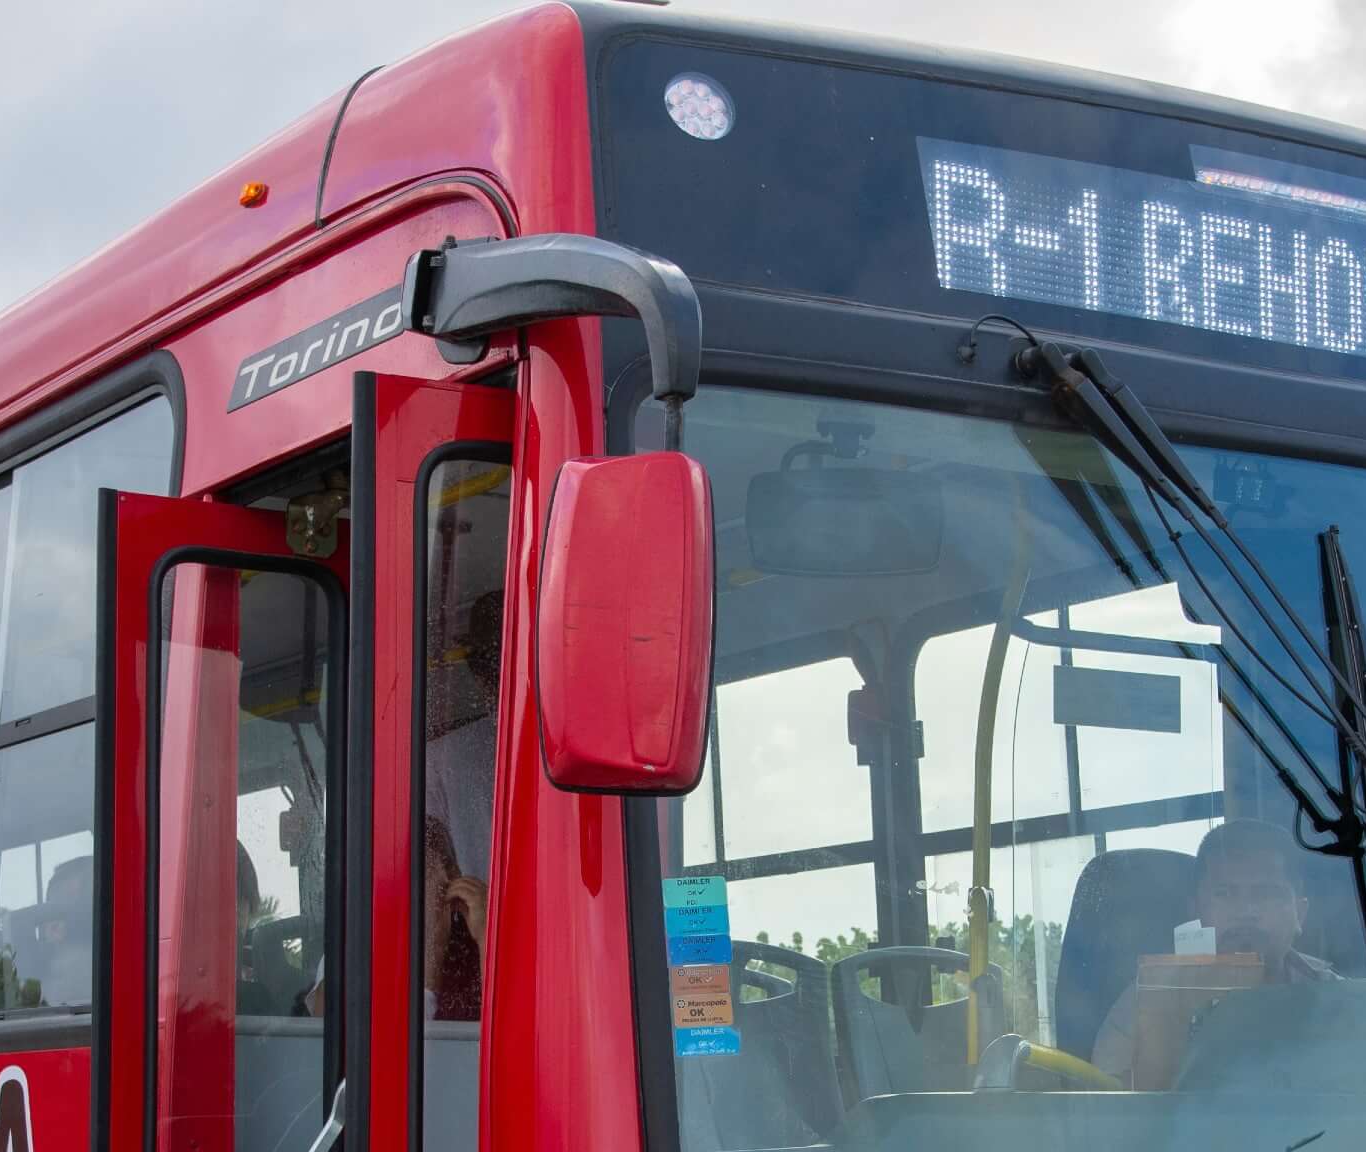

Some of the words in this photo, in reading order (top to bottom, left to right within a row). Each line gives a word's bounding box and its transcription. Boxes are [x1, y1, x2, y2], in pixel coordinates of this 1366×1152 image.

[934, 160, 1099, 310] R-1
[239, 301, 402, 400] Torino
[677, 878, 710, 886] DAIMLER
[690, 1008, 705, 1017] OK
